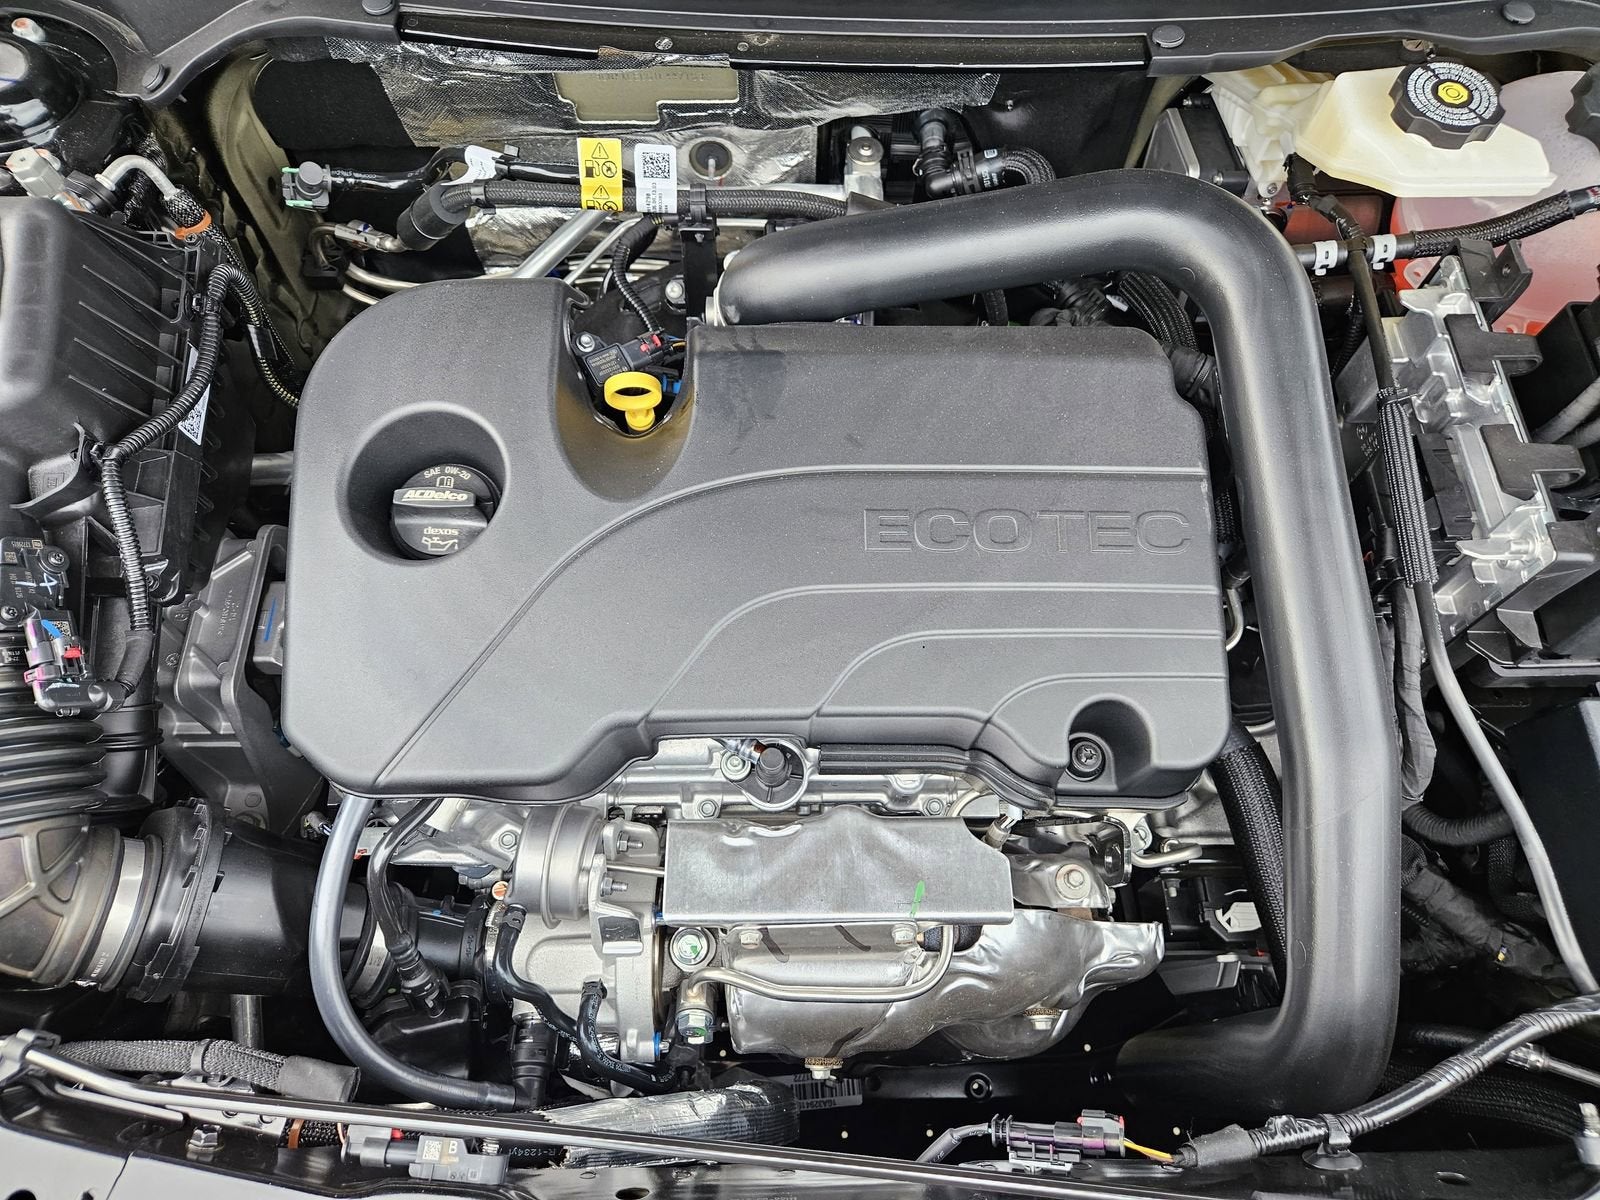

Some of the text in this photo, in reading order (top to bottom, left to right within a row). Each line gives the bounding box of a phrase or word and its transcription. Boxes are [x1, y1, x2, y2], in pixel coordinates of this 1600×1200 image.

[424, 467, 471, 480] SAE 0W-20
[403, 490, 468, 501] ACDelco
[424, 527, 459, 535] dexos
[863, 508, 1192, 555] ECOTEC
[449, 1141, 458, 1154] B
